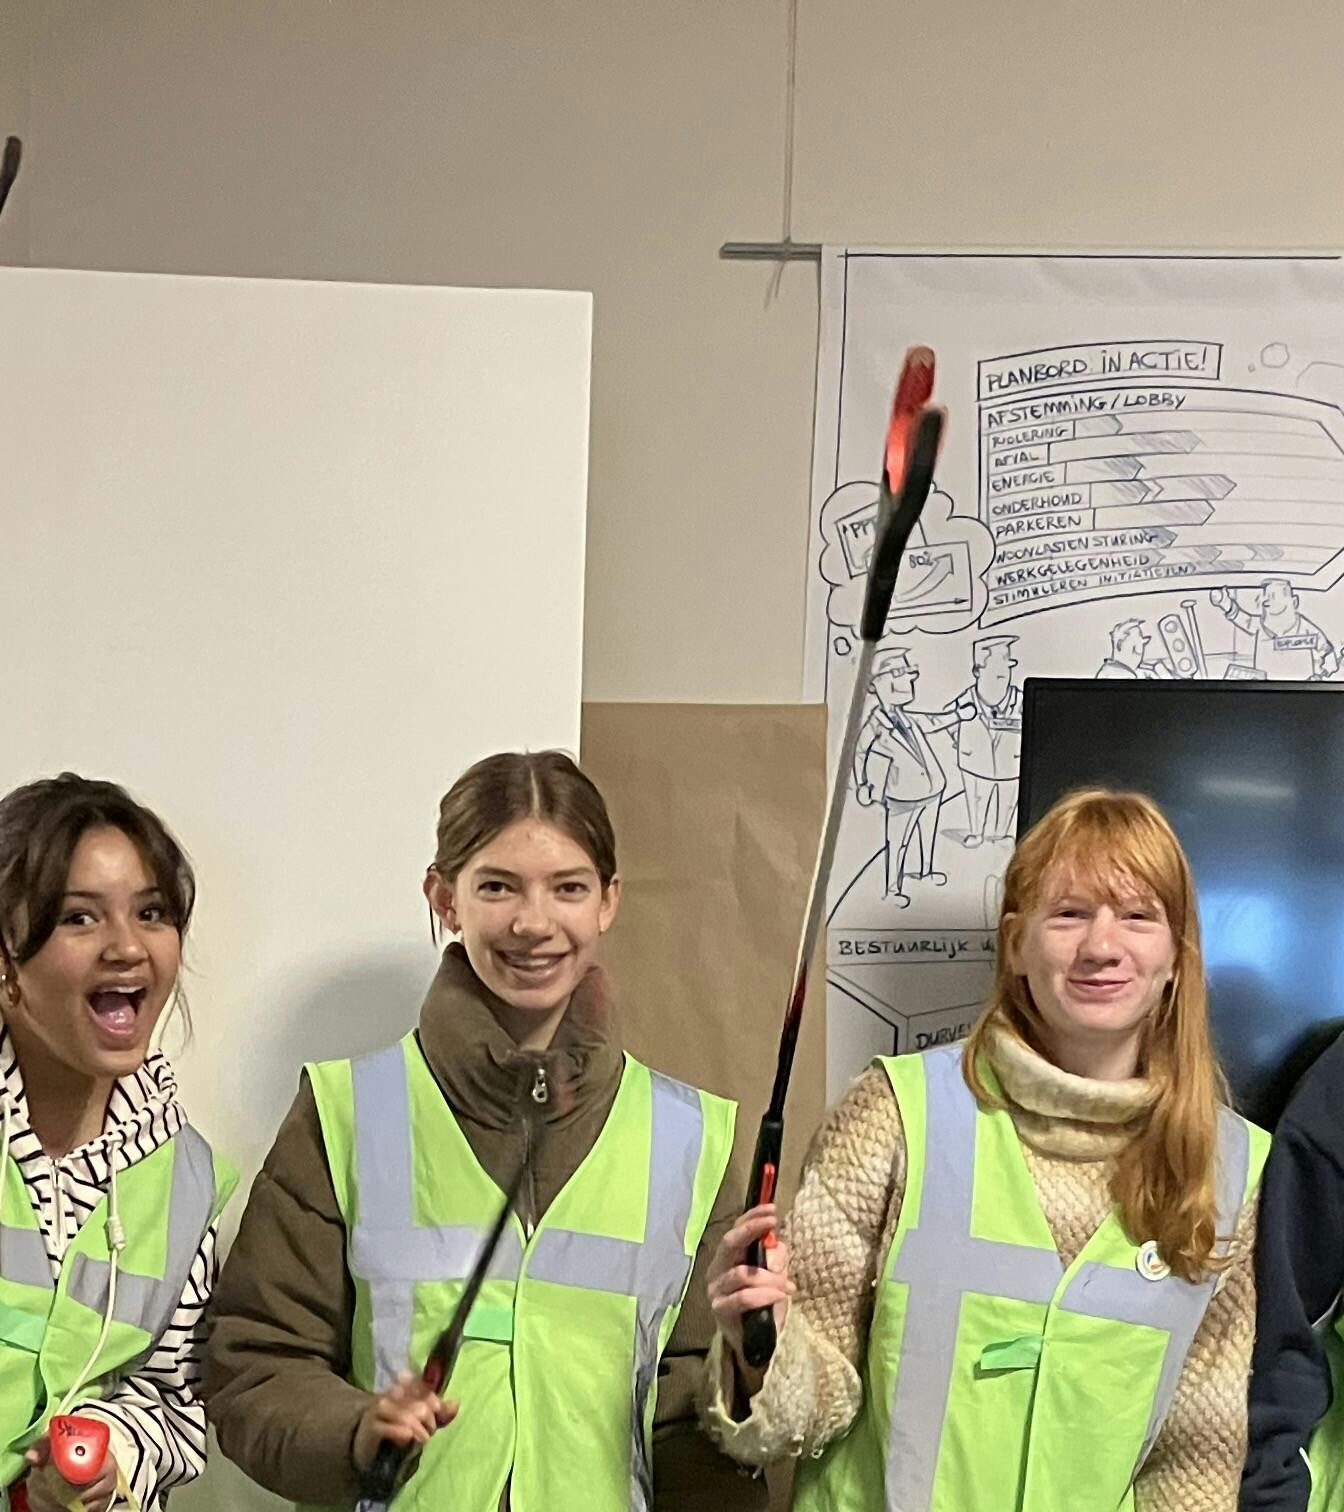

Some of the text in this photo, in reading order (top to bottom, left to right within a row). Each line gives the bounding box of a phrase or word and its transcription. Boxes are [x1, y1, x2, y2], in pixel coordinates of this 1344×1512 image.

[985, 359, 1088, 392] PLANBORD
[1128, 346, 1208, 371] ACTIE!
[991, 470, 1055, 492] ENERGIE
[991, 492, 1083, 516] ONDERHOUD
[996, 515, 1082, 539] PARKEREN
[996, 553, 1150, 586] WERKGELEGENHEID
[838, 939, 969, 959] BESTUURLIJK
